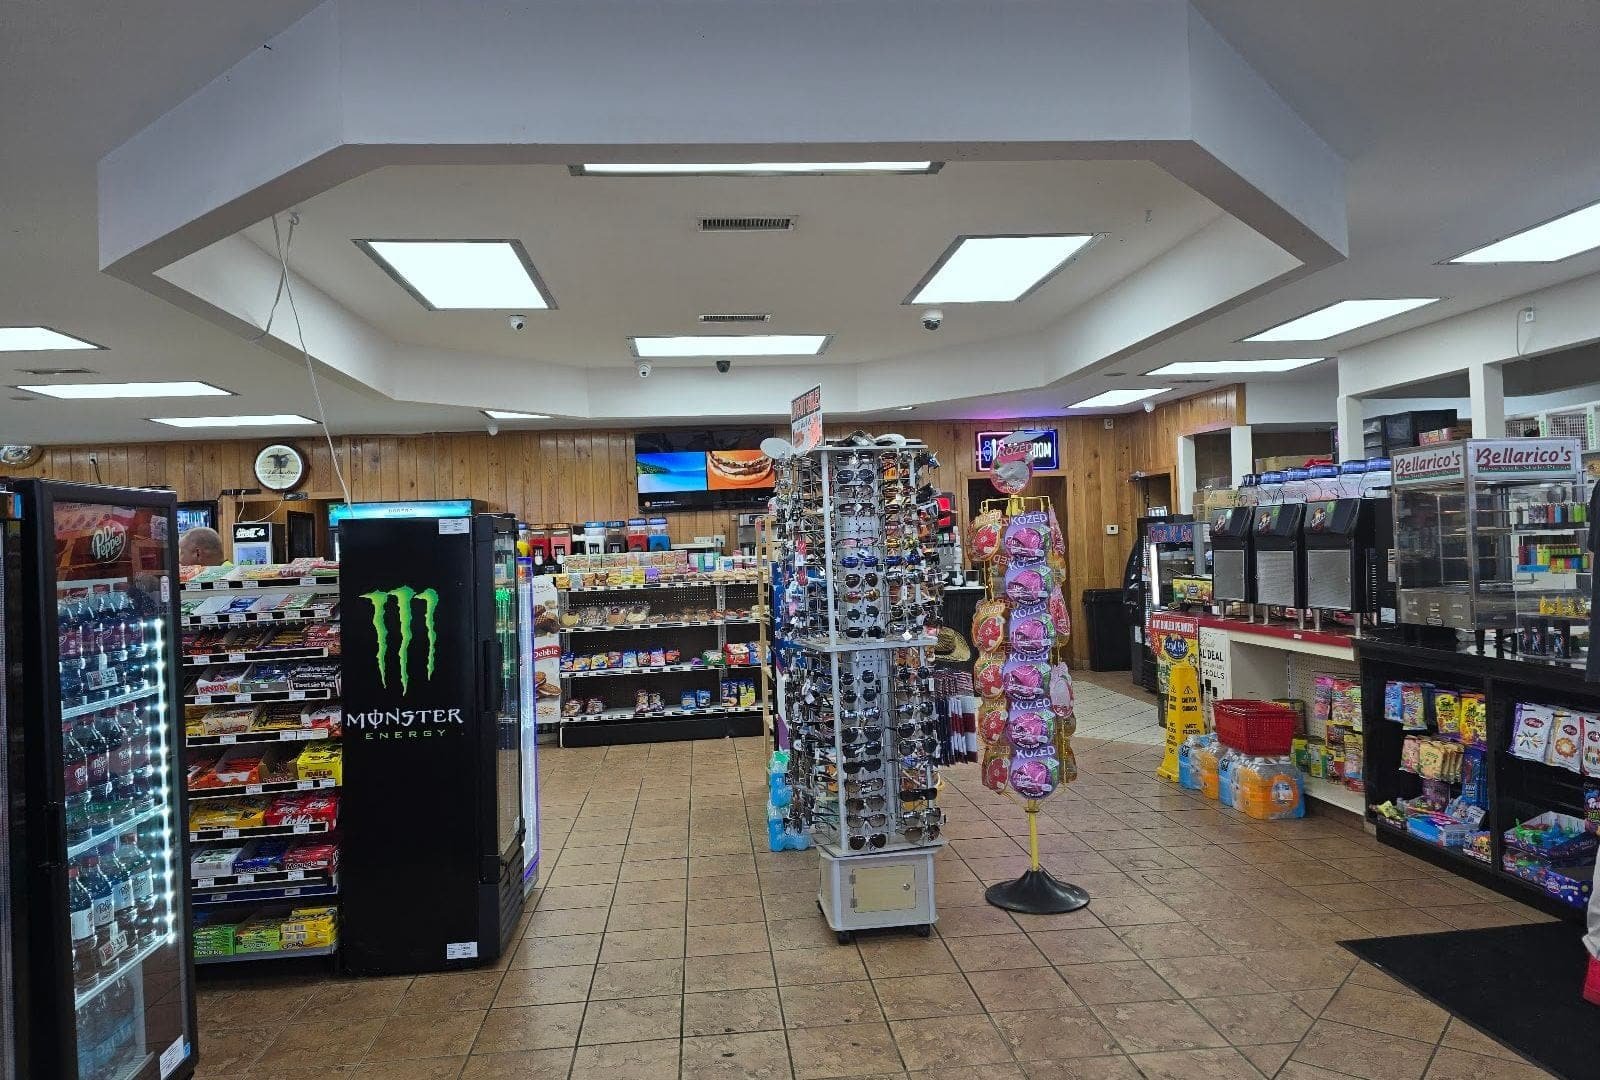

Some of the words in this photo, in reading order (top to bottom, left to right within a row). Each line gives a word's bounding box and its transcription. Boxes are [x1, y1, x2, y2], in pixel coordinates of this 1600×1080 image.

[1395, 450, 1460, 474] Bellarico's
[1476, 446, 1572, 468] Bellarico's
[94, 529, 124, 559] Pepper
[104, 525, 116, 541] Dr
[1207, 649, 1224, 661] DEAL
[346, 707, 464, 729] MONSTER
[365, 729, 446, 740] ENERGY
